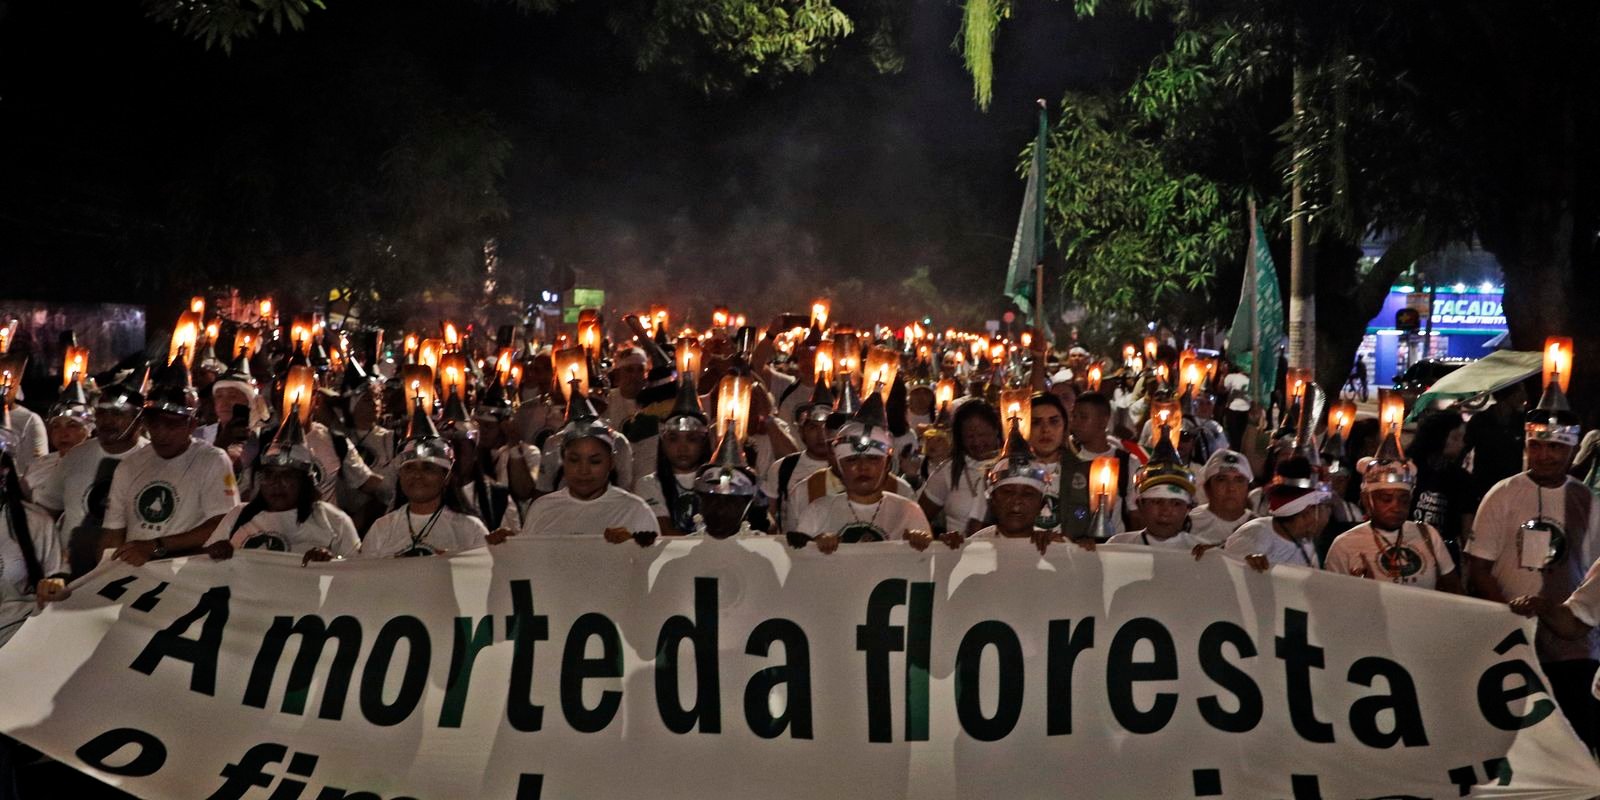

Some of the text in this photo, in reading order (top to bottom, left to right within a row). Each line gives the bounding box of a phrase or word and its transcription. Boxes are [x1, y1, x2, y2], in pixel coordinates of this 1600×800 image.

[242, 580, 624, 735] morte
[655, 576, 814, 741] da
[857, 578, 1430, 750] floresta
[75, 728, 168, 778] o
